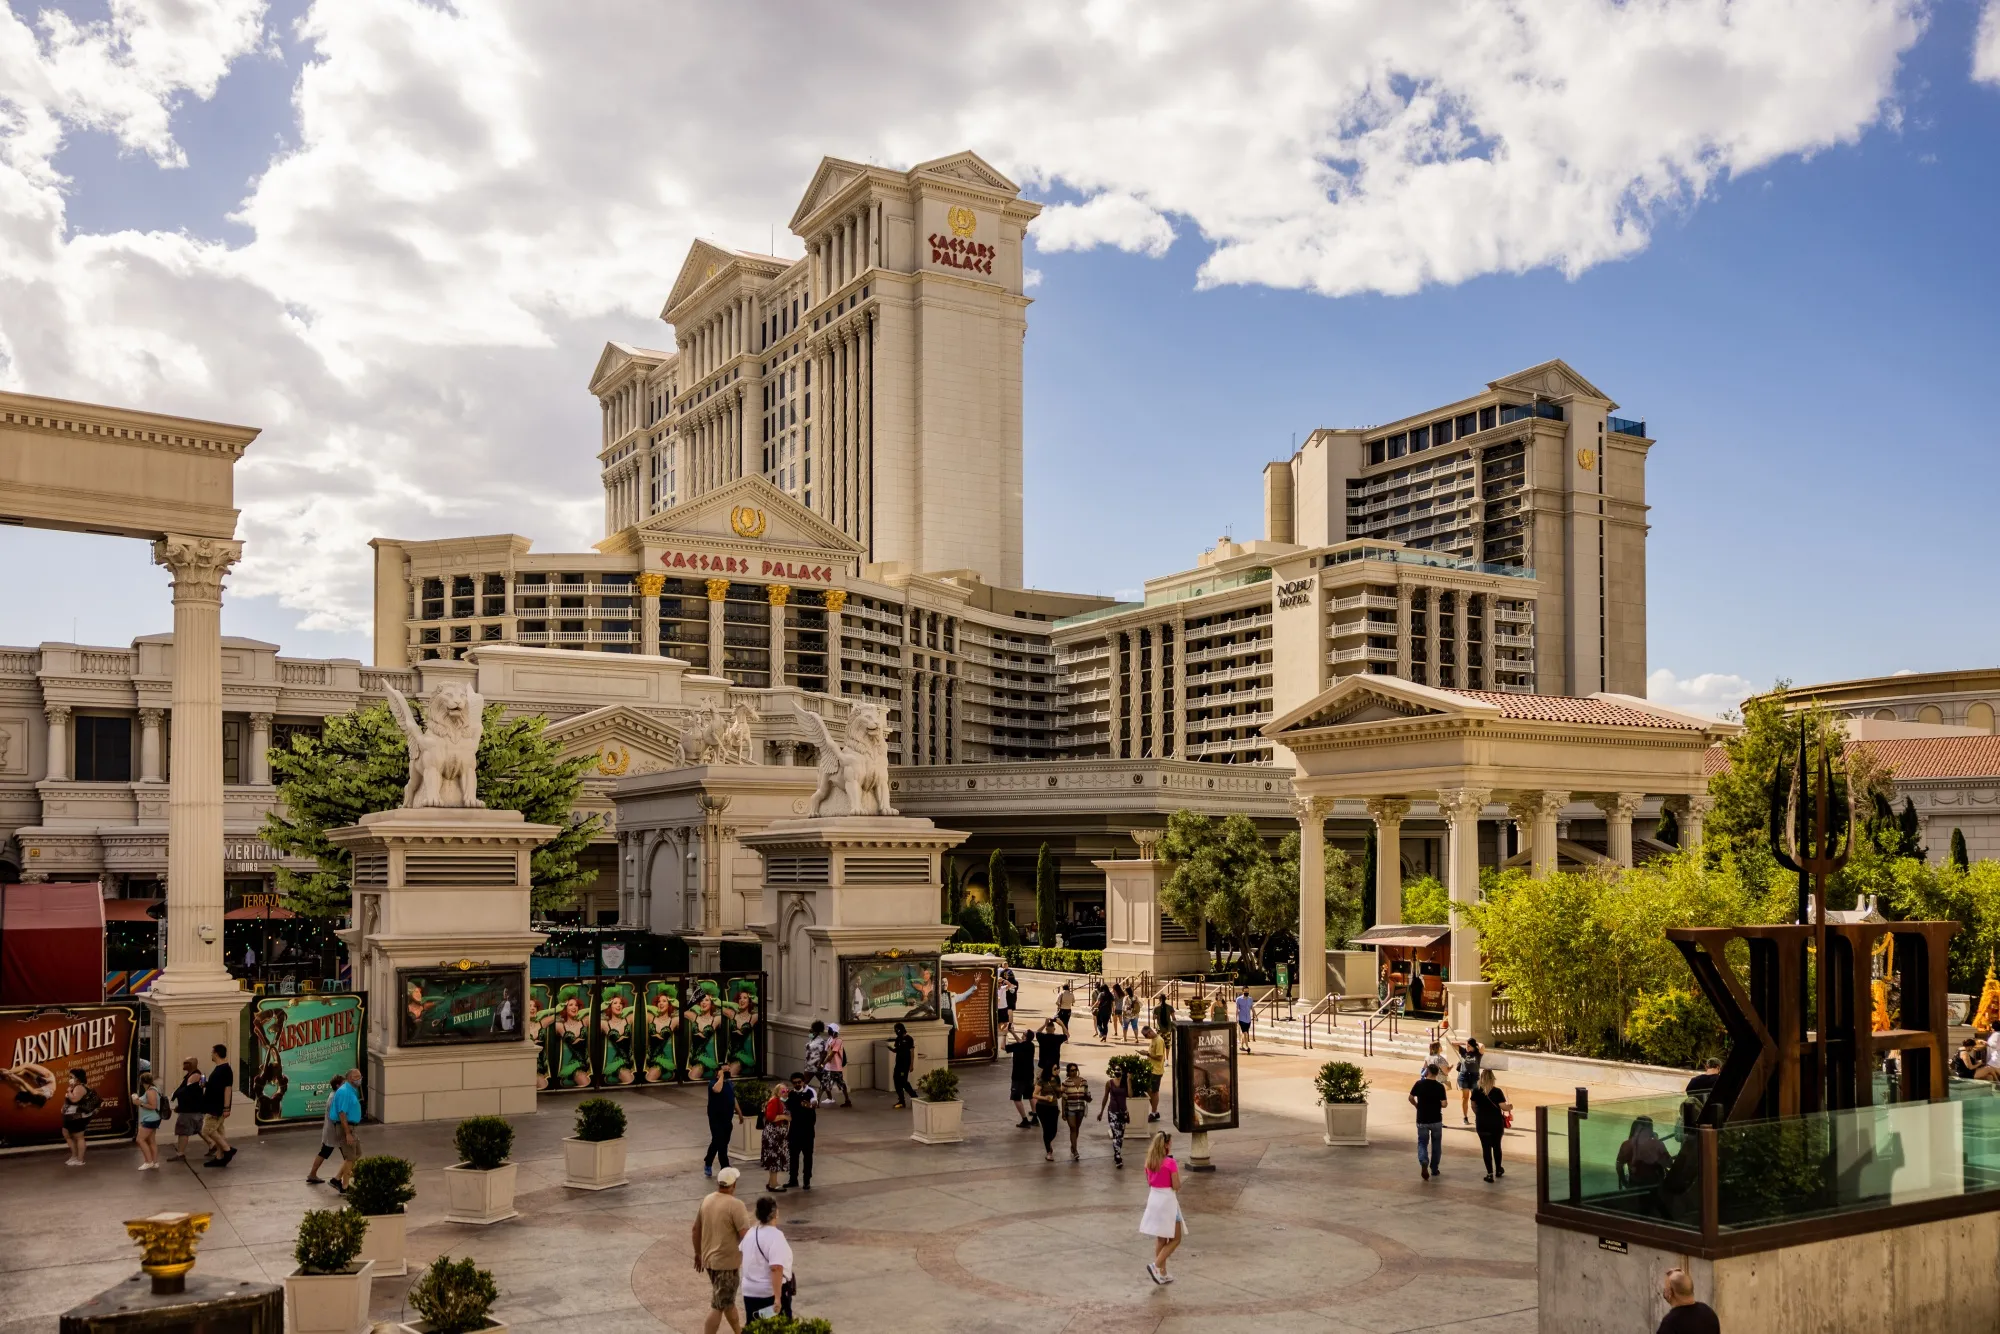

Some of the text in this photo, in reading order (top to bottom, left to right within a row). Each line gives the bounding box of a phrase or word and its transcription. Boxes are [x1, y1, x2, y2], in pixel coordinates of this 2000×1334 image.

[928, 233, 996, 260] CAESARS
[932, 249, 992, 276] PALACE
[660, 550, 833, 583] CAESARS PALACE
[1276, 578, 1314, 597] NOBU
[1279, 594, 1309, 608] HOTEL
[237, 862, 258, 872] HOURS
[242, 893, 281, 908] TERRAZA
[453, 1007, 491, 1025] ENTER HERE
[279, 1008, 355, 1053] ABSINTHE
[12, 1014, 117, 1069] ABSINTHE
[1198, 1034, 1224, 1047] RAO'S
